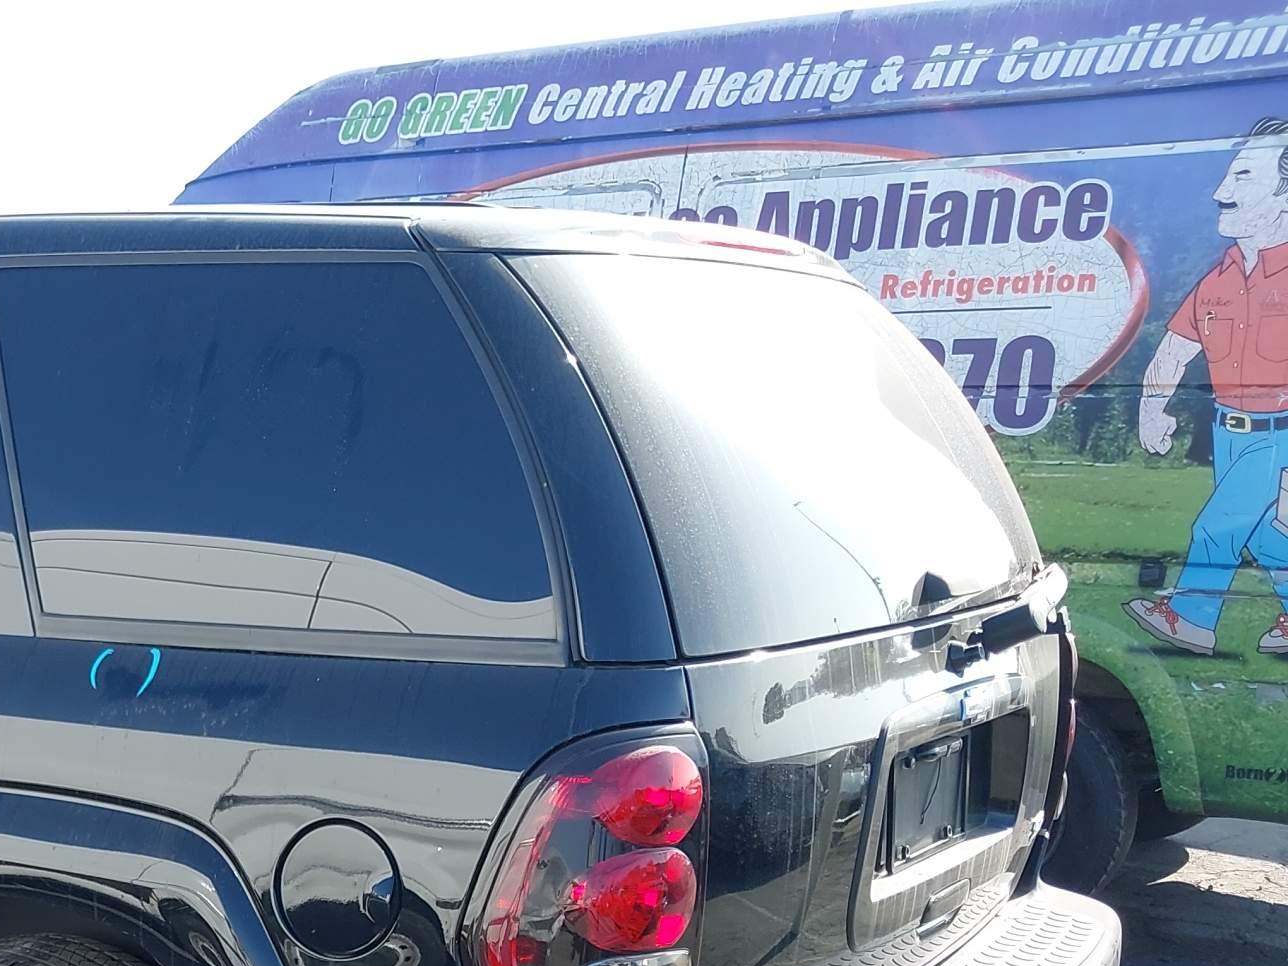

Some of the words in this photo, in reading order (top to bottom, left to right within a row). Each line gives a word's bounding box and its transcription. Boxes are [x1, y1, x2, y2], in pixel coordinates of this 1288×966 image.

[338, 99, 397, 145] GO
[397, 84, 528, 140] GREEN
[527, 71, 688, 125] Central
[685, 56, 868, 110] Heating
[870, 55, 905, 94] &
[912, 42, 995, 90] Air
[997, 6, 1288, 83] Conditioni
[755, 181, 1109, 260] Appliance
[879, 265, 1097, 304] Refrigeration
[918, 335, 1056, 429] 70
